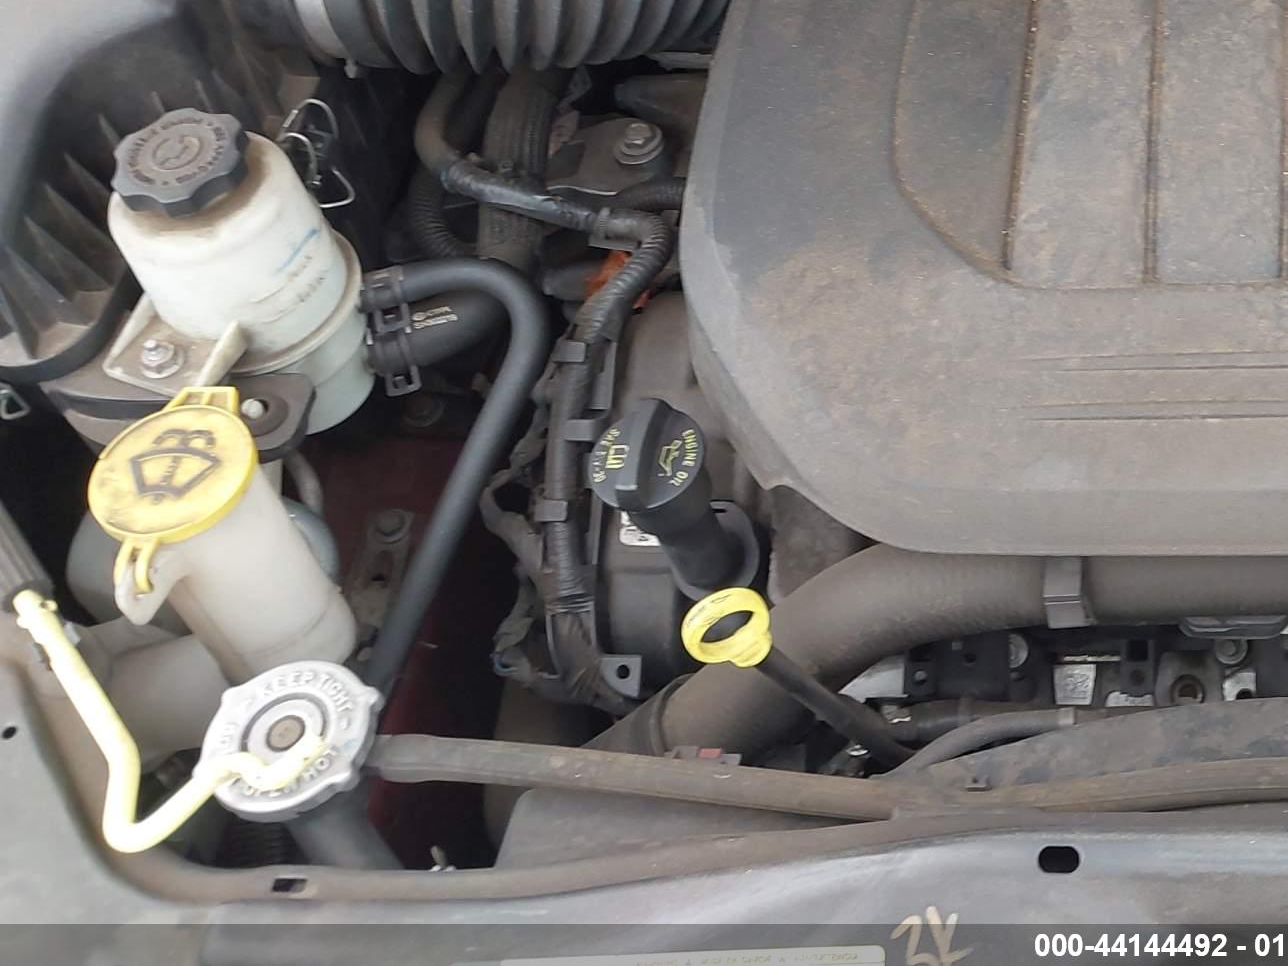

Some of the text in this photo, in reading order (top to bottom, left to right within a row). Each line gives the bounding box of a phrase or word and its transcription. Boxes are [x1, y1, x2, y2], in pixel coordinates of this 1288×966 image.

[668, 428, 699, 487] ENGINE OIL
[263, 670, 314, 697] KEEP
